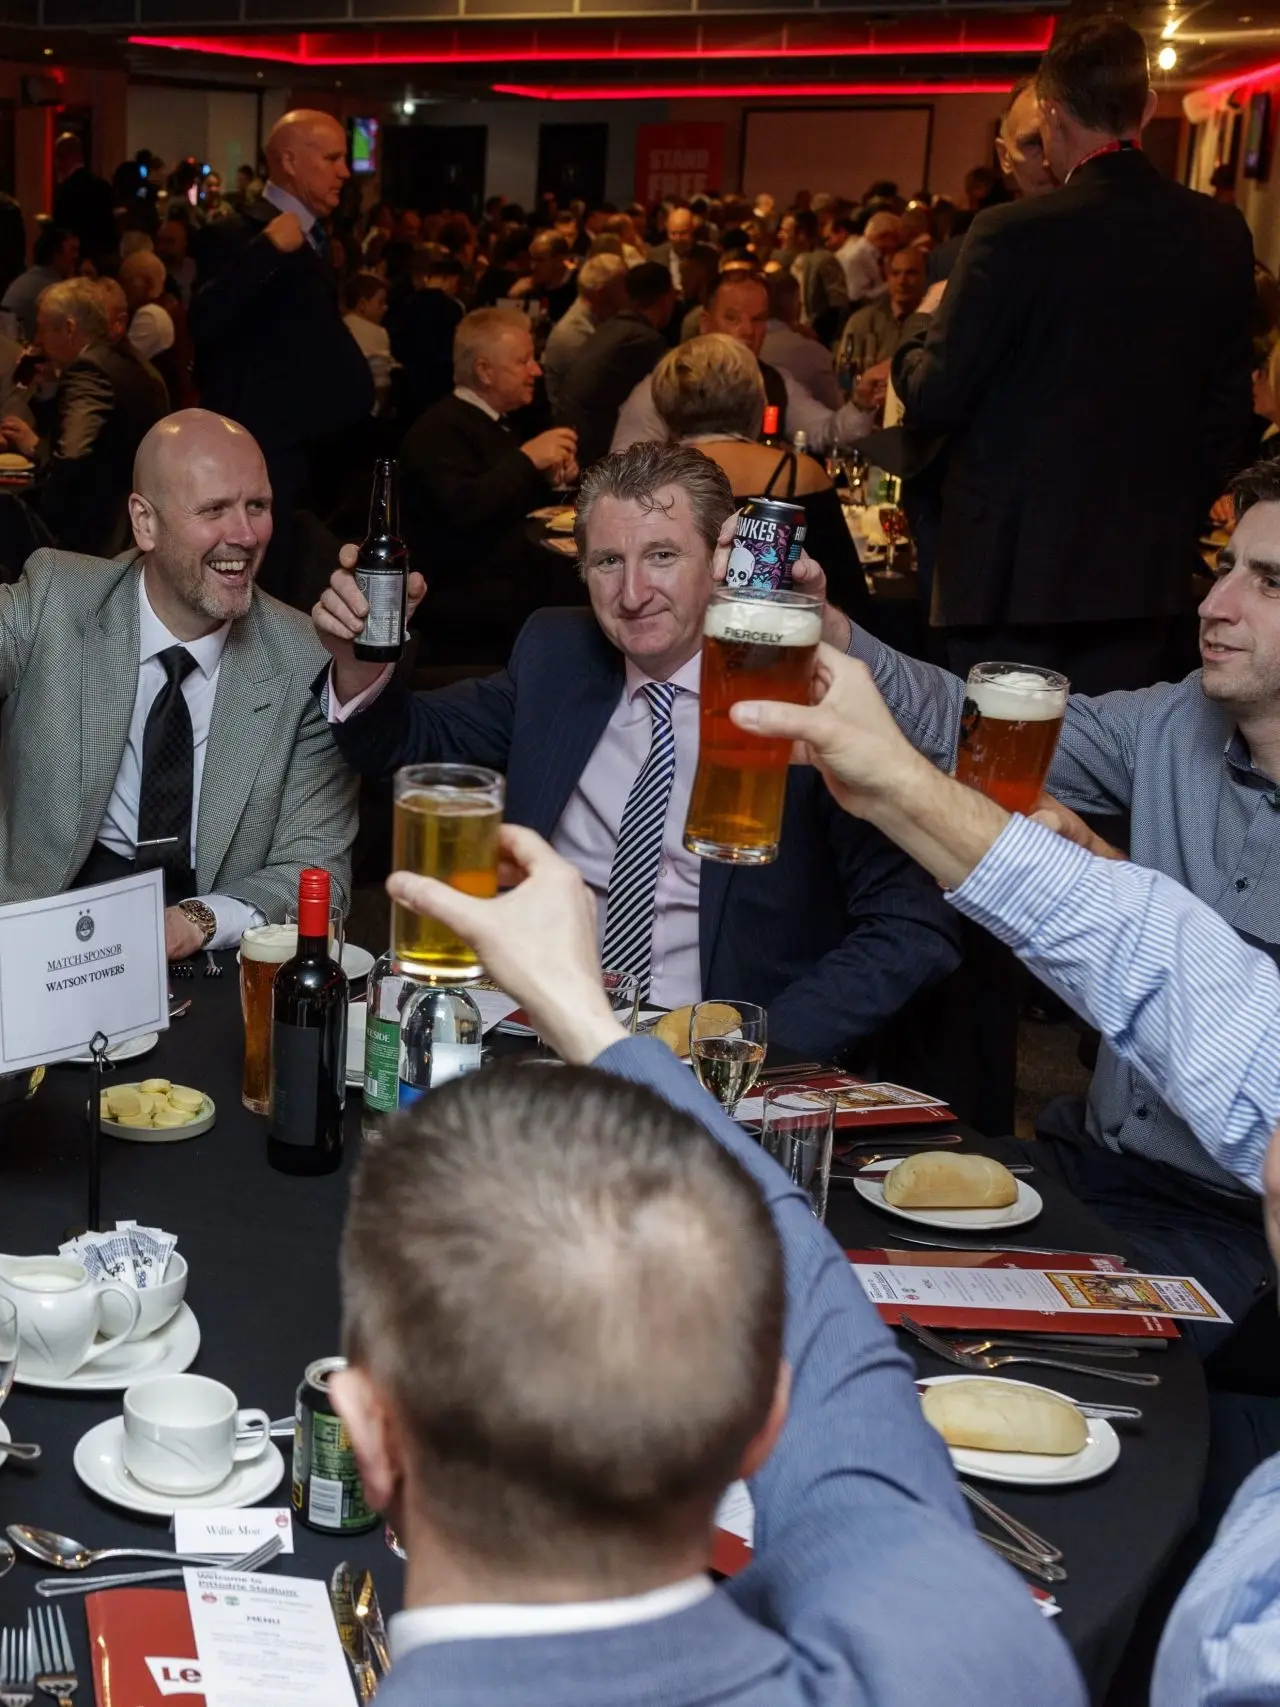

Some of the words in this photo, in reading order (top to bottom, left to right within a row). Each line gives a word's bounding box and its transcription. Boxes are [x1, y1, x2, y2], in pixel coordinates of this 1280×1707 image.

[649, 149, 709, 171] STAND
[737, 516, 777, 542] WKES
[724, 626, 784, 643] FIERCELY
[47, 953, 82, 972] MATCH
[83, 943, 122, 963] SPONSOR
[46, 974, 87, 992] WATSON
[89, 964, 125, 982] TOWERS
